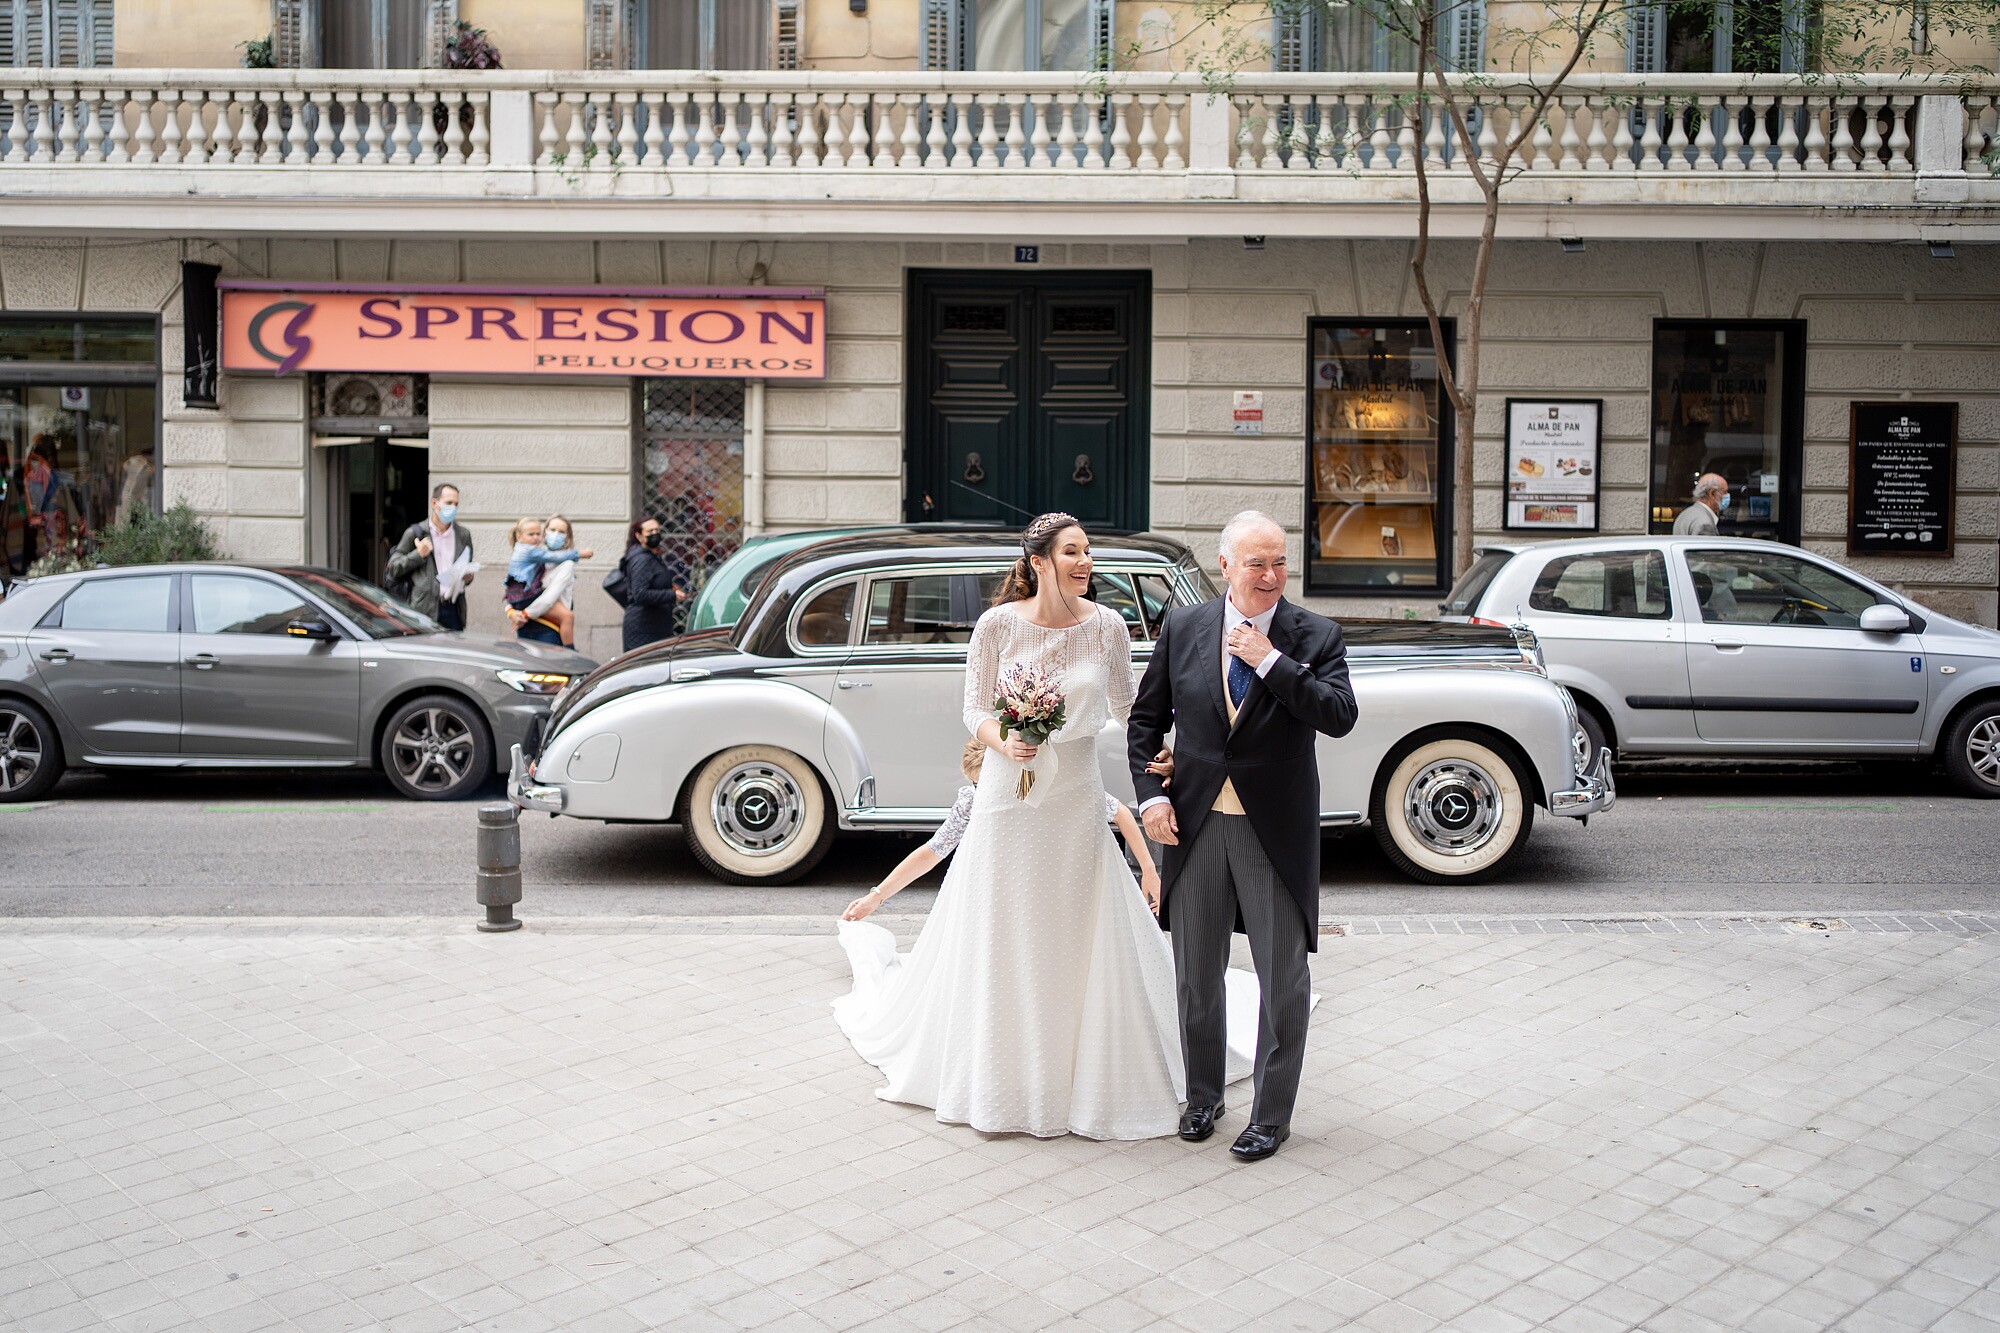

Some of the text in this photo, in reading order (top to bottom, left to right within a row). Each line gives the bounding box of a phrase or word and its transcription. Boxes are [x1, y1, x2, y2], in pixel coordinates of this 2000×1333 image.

[1020, 248, 1034, 260] 72
[358, 298, 814, 344] SPRESION
[536, 354, 813, 371] PELUQUEROS
[1331, 377, 1424, 392] ALMA DE PAN
[1361, 394, 1393, 403] Madrid
[1527, 422, 1580, 431] ALMA DE PAN
